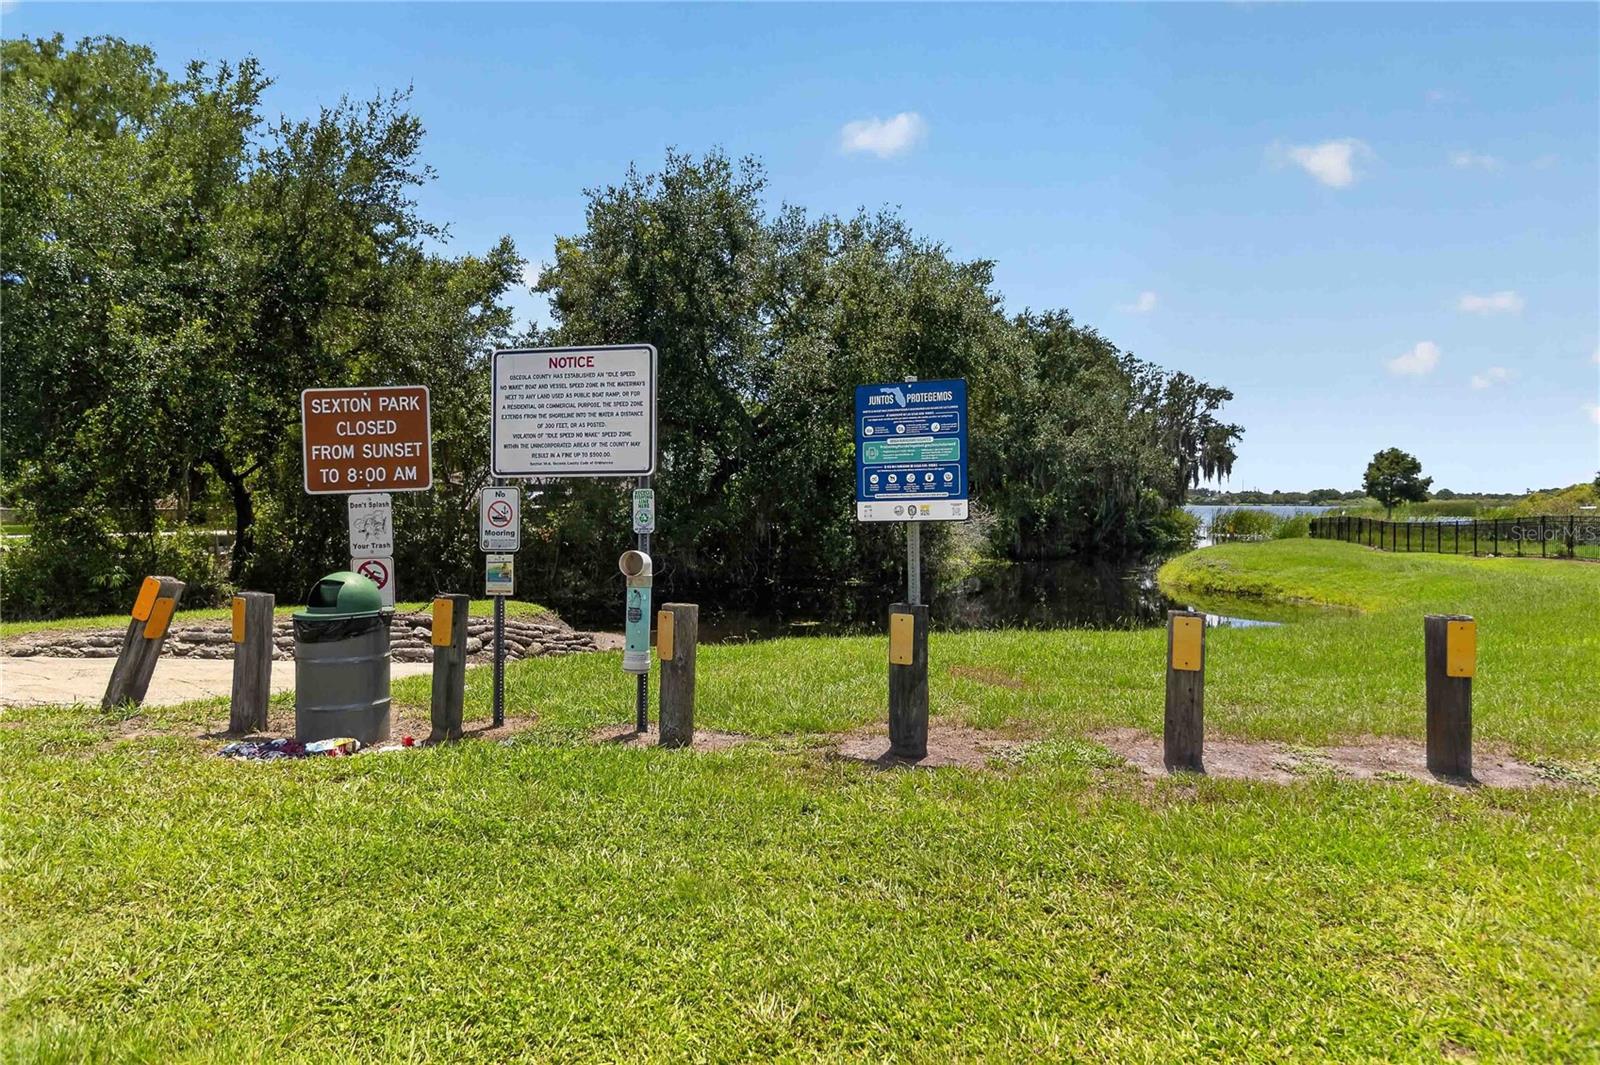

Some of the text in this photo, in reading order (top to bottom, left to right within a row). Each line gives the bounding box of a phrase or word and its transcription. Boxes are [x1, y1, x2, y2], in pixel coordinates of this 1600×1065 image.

[548, 356, 594, 369] NOTICE
[311, 396, 420, 414] SEXTON PARK
[868, 392, 952, 405] JUNTOS PROTEGEMOS
[336, 420, 397, 436] CLOSED
[311, 442, 422, 460] FROM SUNSET
[320, 466, 417, 483] TO 8:00 AM
